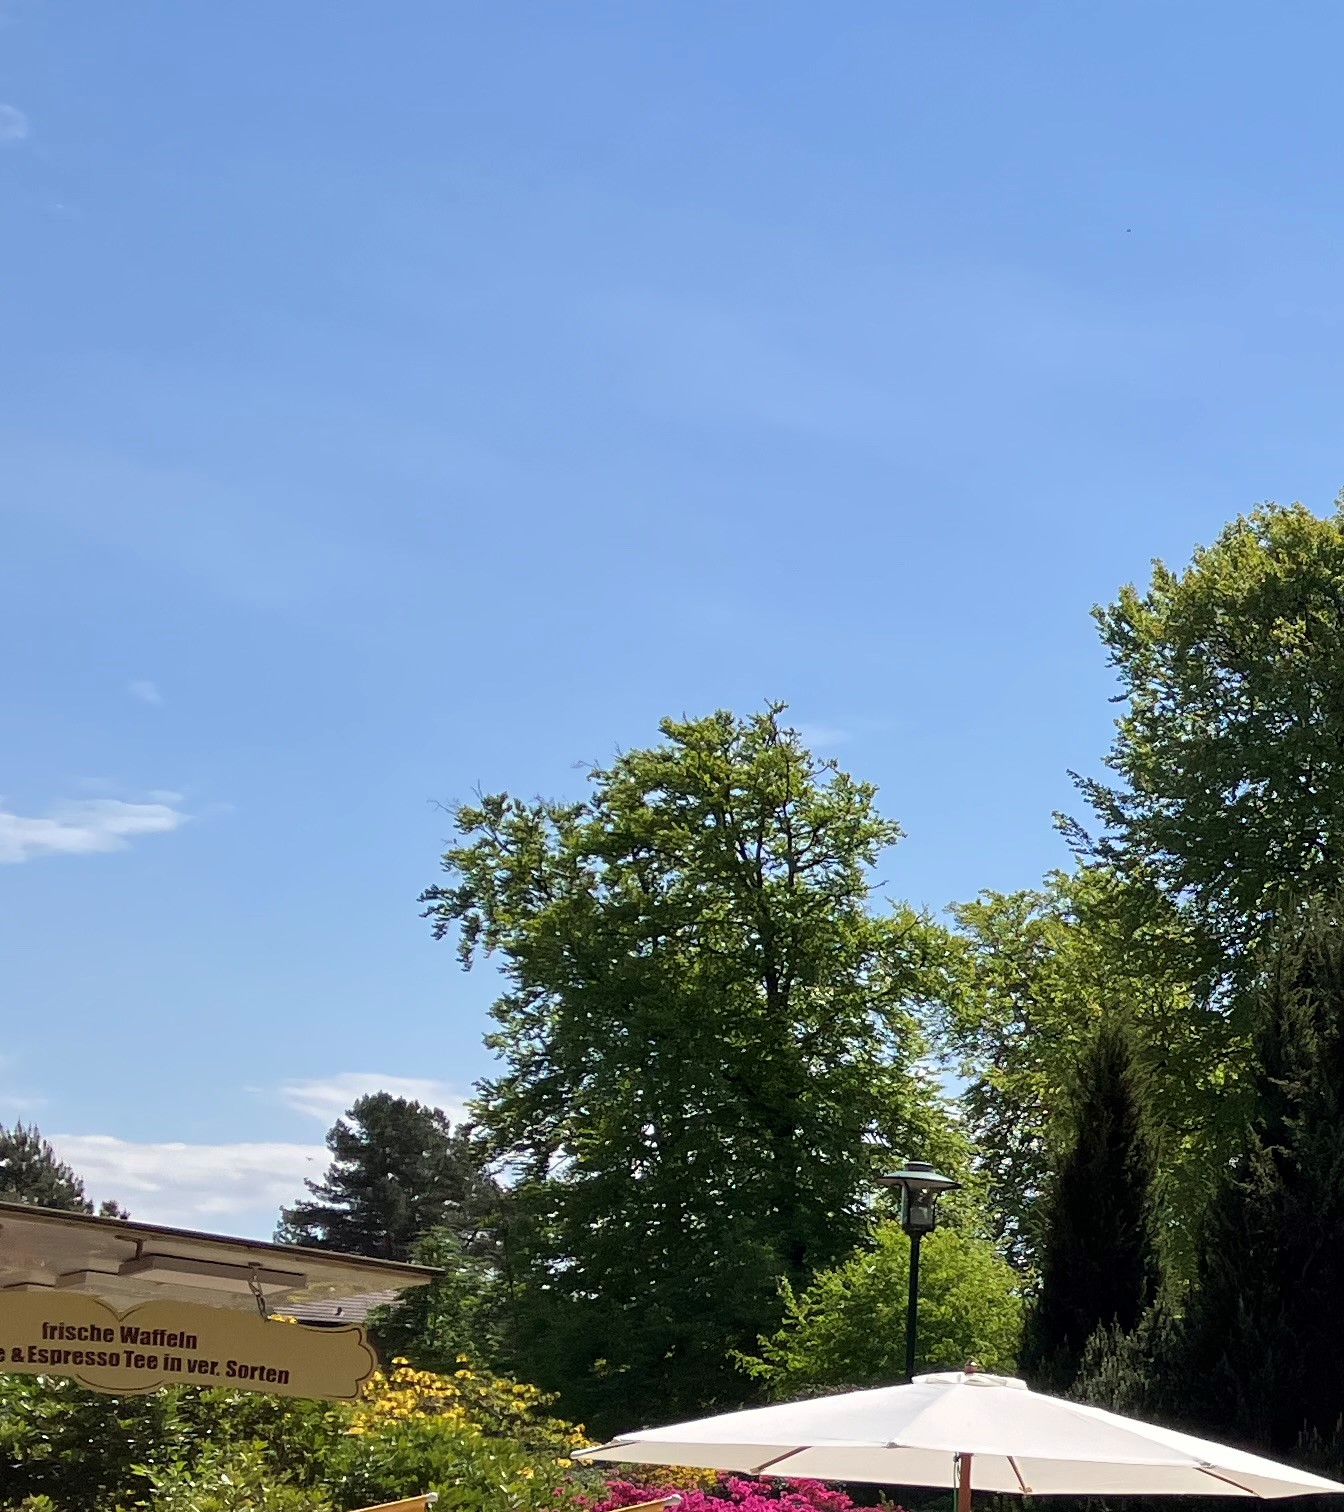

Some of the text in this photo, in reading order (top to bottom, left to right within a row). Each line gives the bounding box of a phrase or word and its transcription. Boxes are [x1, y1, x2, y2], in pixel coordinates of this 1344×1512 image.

[42, 1321, 198, 1350] frische Waffeln
[28, 1346, 120, 1367] Espresso
[124, 1350, 158, 1370] Tee
[163, 1353, 182, 1373] in
[187, 1358, 220, 1378] ver.
[225, 1360, 290, 1385] Sorten
